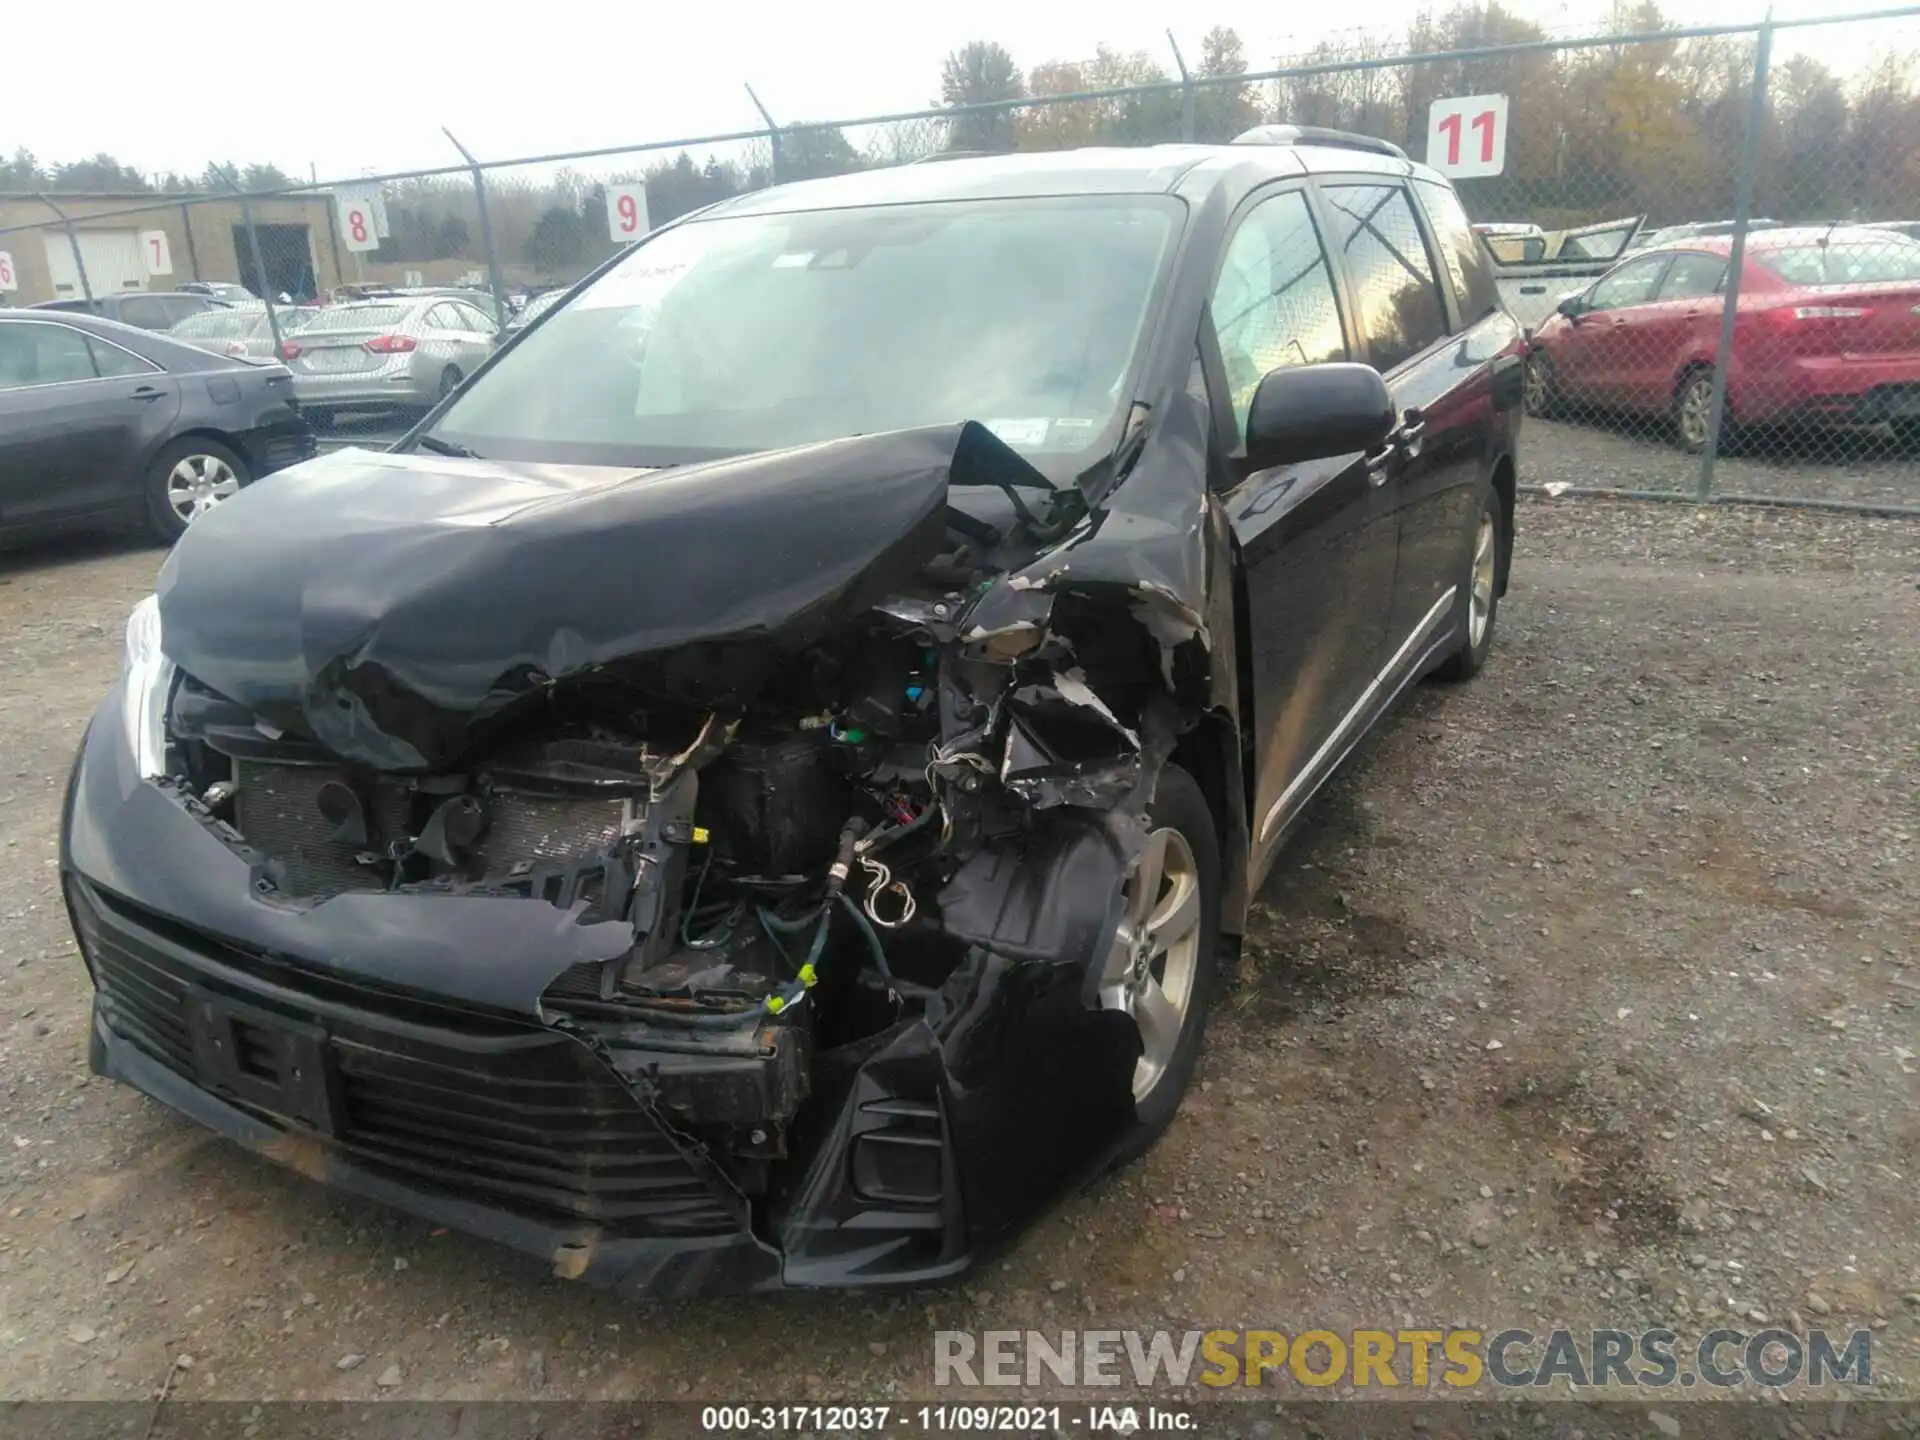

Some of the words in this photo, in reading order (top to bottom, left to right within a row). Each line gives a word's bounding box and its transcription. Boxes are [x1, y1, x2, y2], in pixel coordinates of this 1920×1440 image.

[1438, 109, 1496, 165] 11
[349, 210, 367, 242] 8
[617, 194, 637, 232] 9
[149, 239, 161, 269] 7
